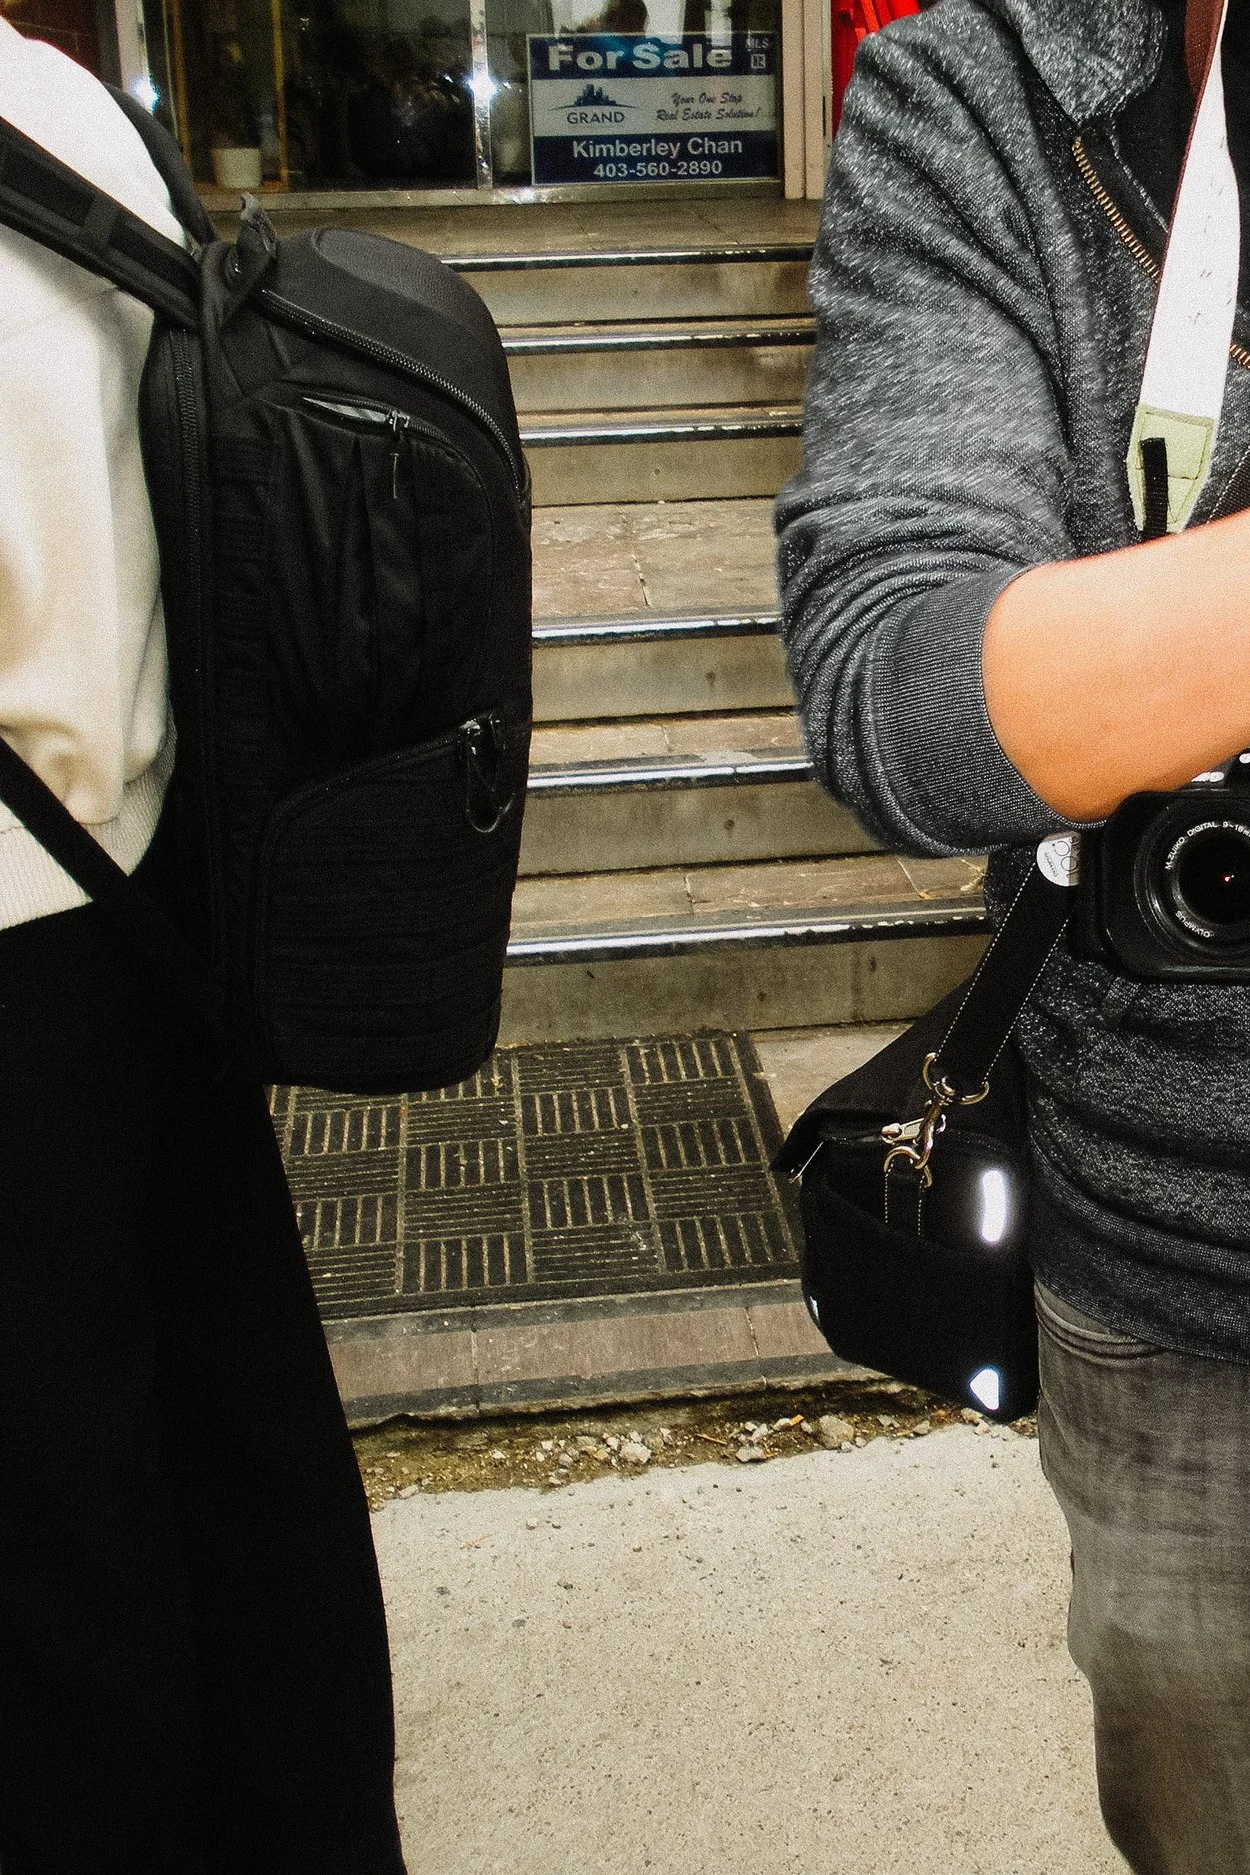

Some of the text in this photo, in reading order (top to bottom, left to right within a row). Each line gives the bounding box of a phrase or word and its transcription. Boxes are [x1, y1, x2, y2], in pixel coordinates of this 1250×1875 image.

[548, 42, 733, 71] For Sale
[672, 92, 743, 107] Your One Stop
[566, 111, 625, 125] GRAND
[656, 108, 679, 121] Real
[682, 108, 712, 121] Estate
[572, 137, 743, 158] Kimberley Chan
[593, 160, 722, 178] 403-560-2890
[1186, 821, 1218, 837] DIGITAL
[1175, 910, 1211, 938] OLYMPUS
